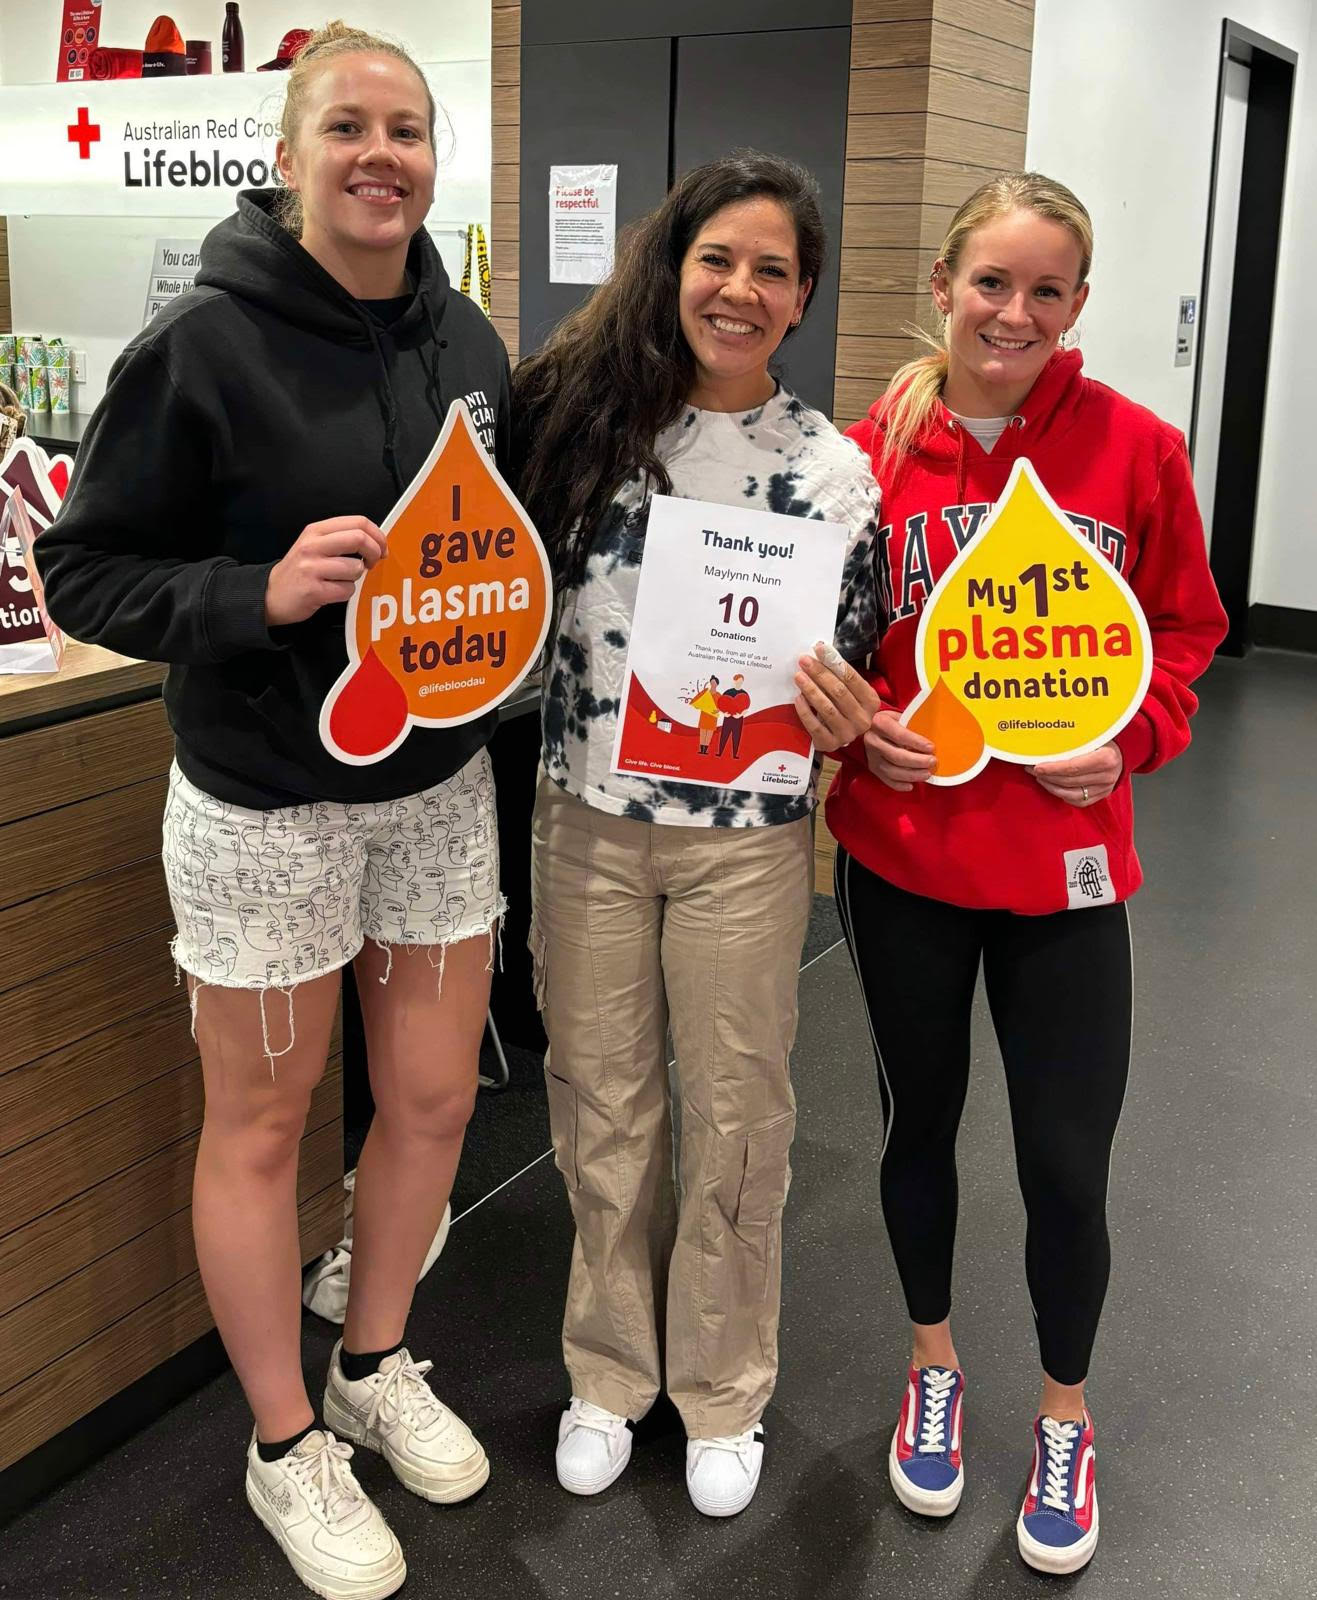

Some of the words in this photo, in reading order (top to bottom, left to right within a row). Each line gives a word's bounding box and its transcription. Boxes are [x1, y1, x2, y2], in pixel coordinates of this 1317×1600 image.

[124, 120, 200, 141] Australian
[206, 118, 238, 139] Red
[244, 117, 283, 138] Cros
[584, 186, 595, 197] be
[555, 198, 599, 210] respectful
[163, 249, 180, 266] You
[156, 280, 181, 293] Whole
[182, 281, 196, 293] blo
[465, 391, 487, 408] NTI
[472, 408, 495, 427] CIA
[453, 485, 460, 521] I
[419, 527, 516, 578] gave
[702, 529, 754, 552] Thank
[758, 543, 794, 559] you!
[704, 565, 749, 581] Maylynn
[752, 572, 781, 586] Nunn
[967, 578, 1017, 614] My
[1018, 561, 1090, 618] 1st
[371, 577, 530, 642] plasma
[718, 593, 759, 627] 10
[711, 628, 757, 643] Donations
[938, 614, 1132, 672] plasma
[400, 625, 506, 673] today
[688, 651, 716, 660] Australian
[729, 657, 745, 665] Cross
[695, 644, 711, 652] Thank
[418, 677, 486, 697] @lifebloodau
[963, 668, 1109, 699] donation
[997, 719, 1075, 731] @lifebloodau
[762, 775, 799, 785] Lifeblood
